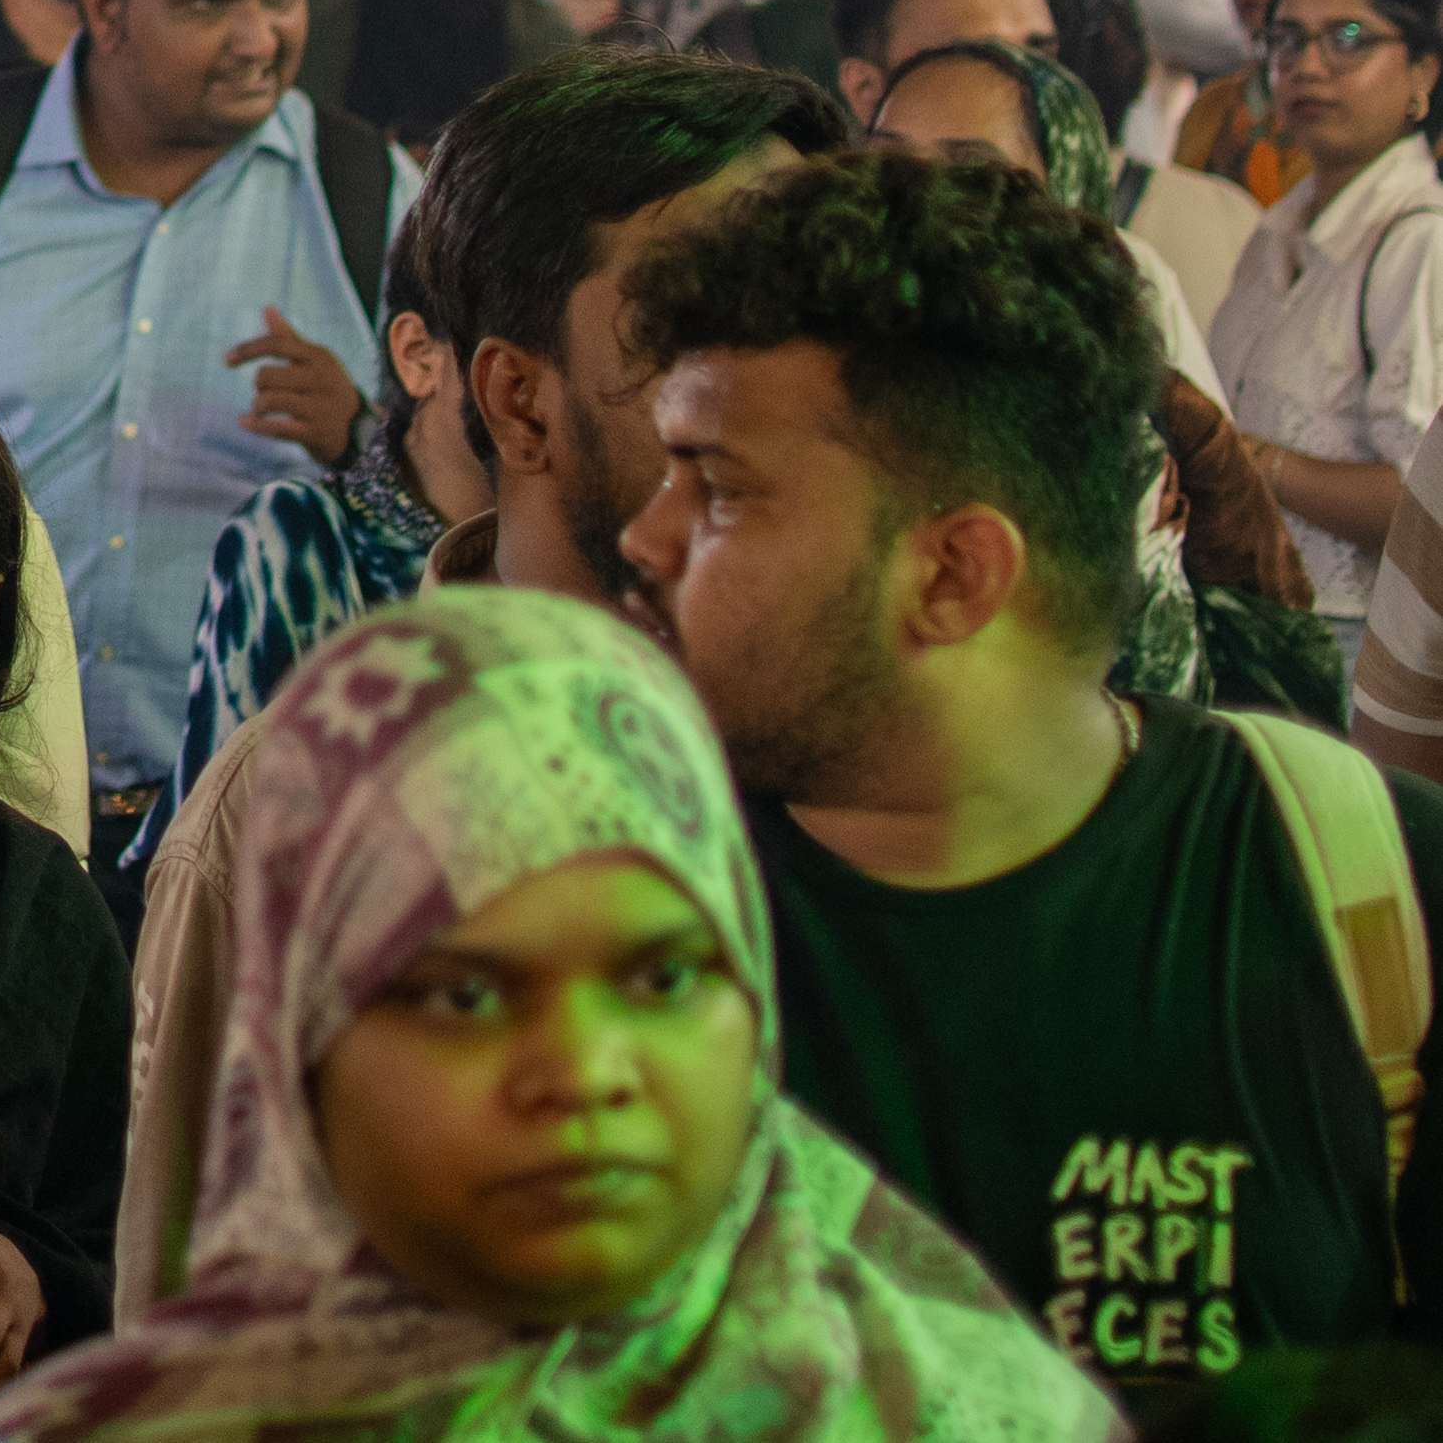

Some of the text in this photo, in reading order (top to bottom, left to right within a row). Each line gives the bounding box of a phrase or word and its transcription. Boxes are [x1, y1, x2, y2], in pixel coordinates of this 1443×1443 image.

[1051, 1133, 1255, 1212] MAST
[1052, 1212, 1234, 1289] ERPI
[1044, 1288, 1241, 1373] ECES
